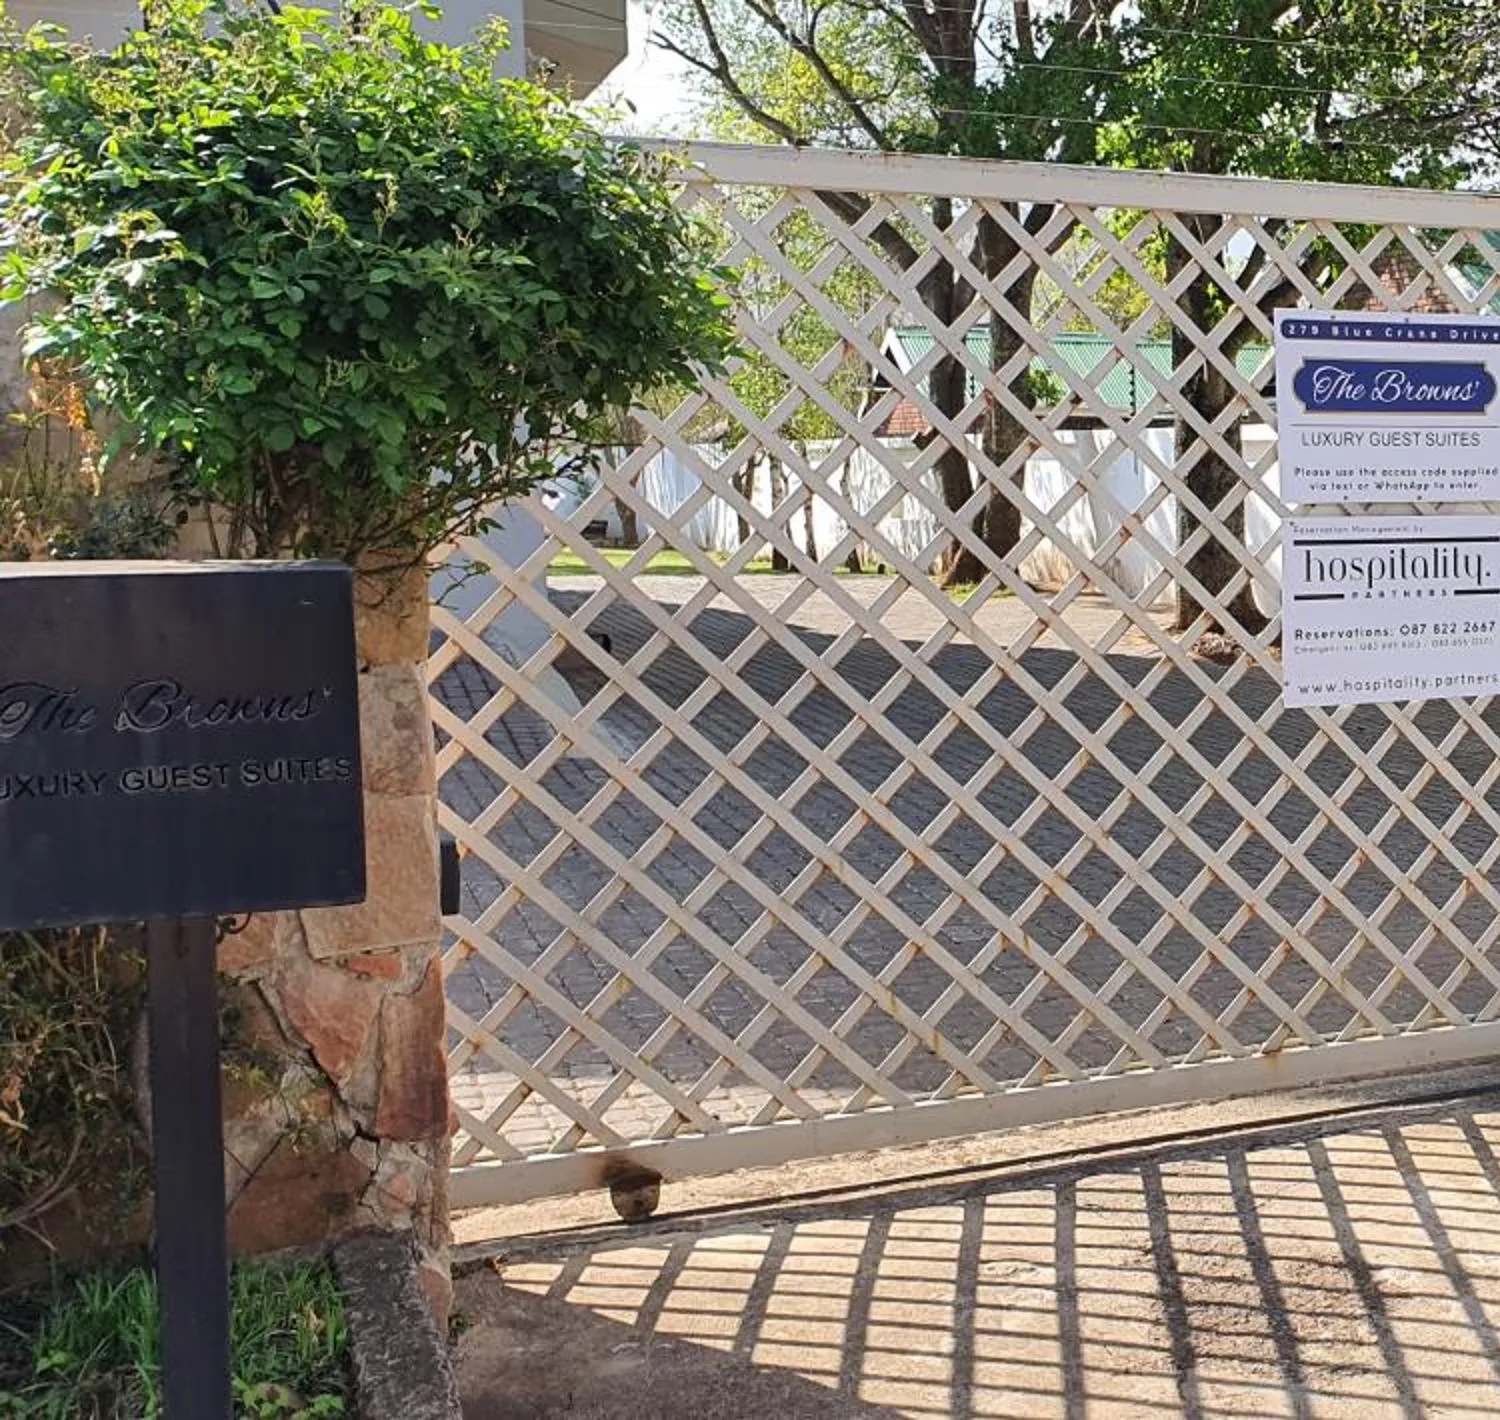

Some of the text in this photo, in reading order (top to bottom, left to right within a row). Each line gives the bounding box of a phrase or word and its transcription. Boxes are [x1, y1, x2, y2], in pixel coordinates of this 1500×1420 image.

[1288, 324, 1499, 341] 279 Blue Crane Drive
[1312, 365, 1366, 404] The
[1301, 431, 1481, 447] LUXURY GUEST SUITES
[1294, 466, 1499, 478] Please use the access code supplied
[1309, 480, 1327, 491] via
[1331, 480, 1353, 490] text
[1357, 482, 1369, 490] or
[1373, 480, 1430, 491] WhatsApp
[1351, 588, 1448, 599] PARTNERS
[1294, 627, 1395, 641] Reservations:
[1399, 622, 1427, 636] 087
[1297, 672, 1500, 695] www.hospitality.partners
[0, 681, 99, 743] The
[119, 763, 232, 795] GUEST
[240, 756, 352, 786] SUITES
